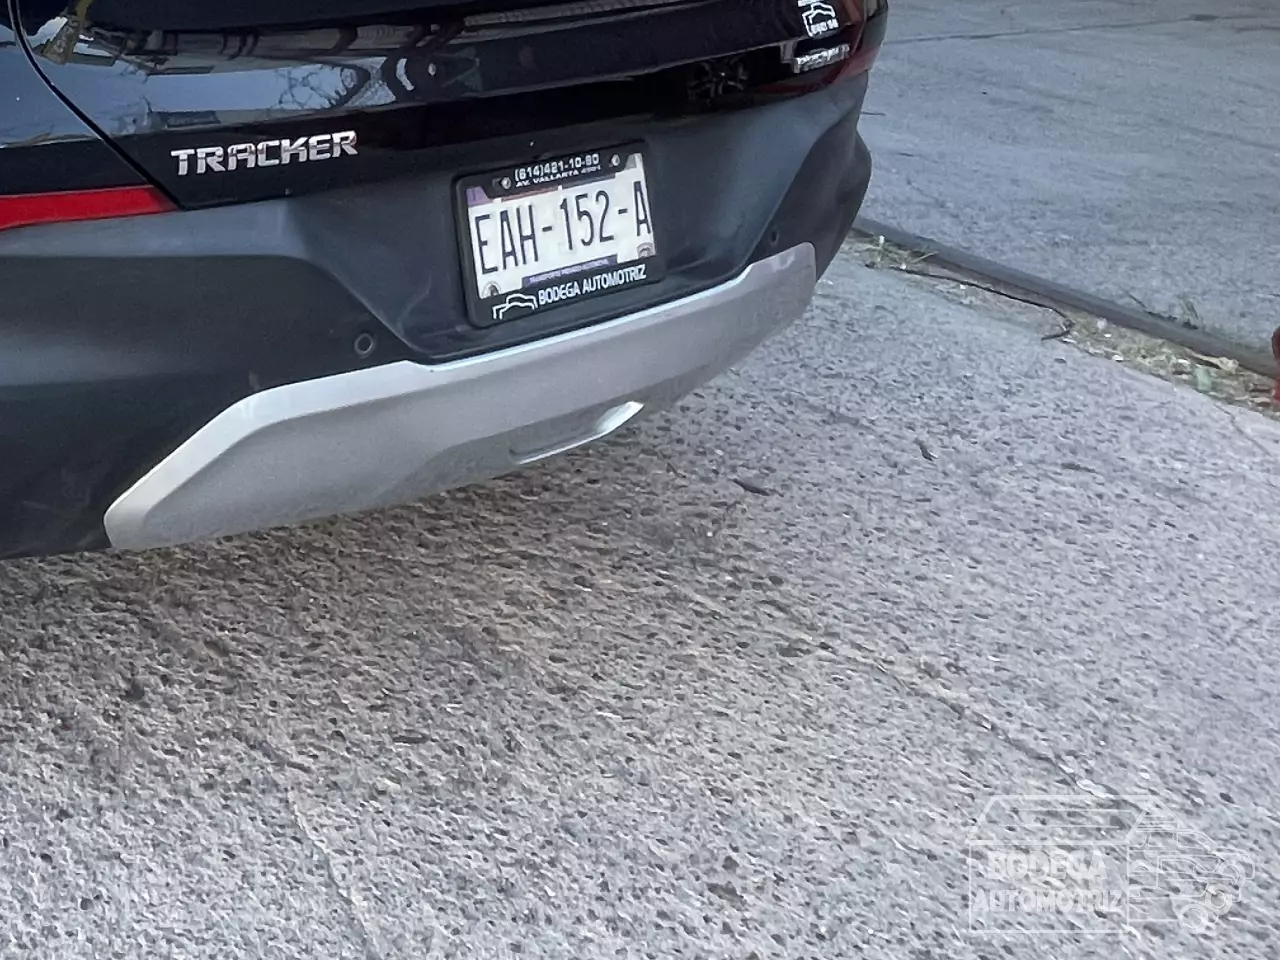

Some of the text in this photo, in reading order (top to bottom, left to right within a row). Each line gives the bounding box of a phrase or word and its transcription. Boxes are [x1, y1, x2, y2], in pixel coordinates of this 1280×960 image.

[170, 130, 358, 175] TRACKER
[533, 169, 579, 183] VALLARTA
[474, 181, 652, 275] EAH-152-A
[538, 281, 581, 305] BODEGA
[582, 264, 647, 294] AUTOMOTRIZ
